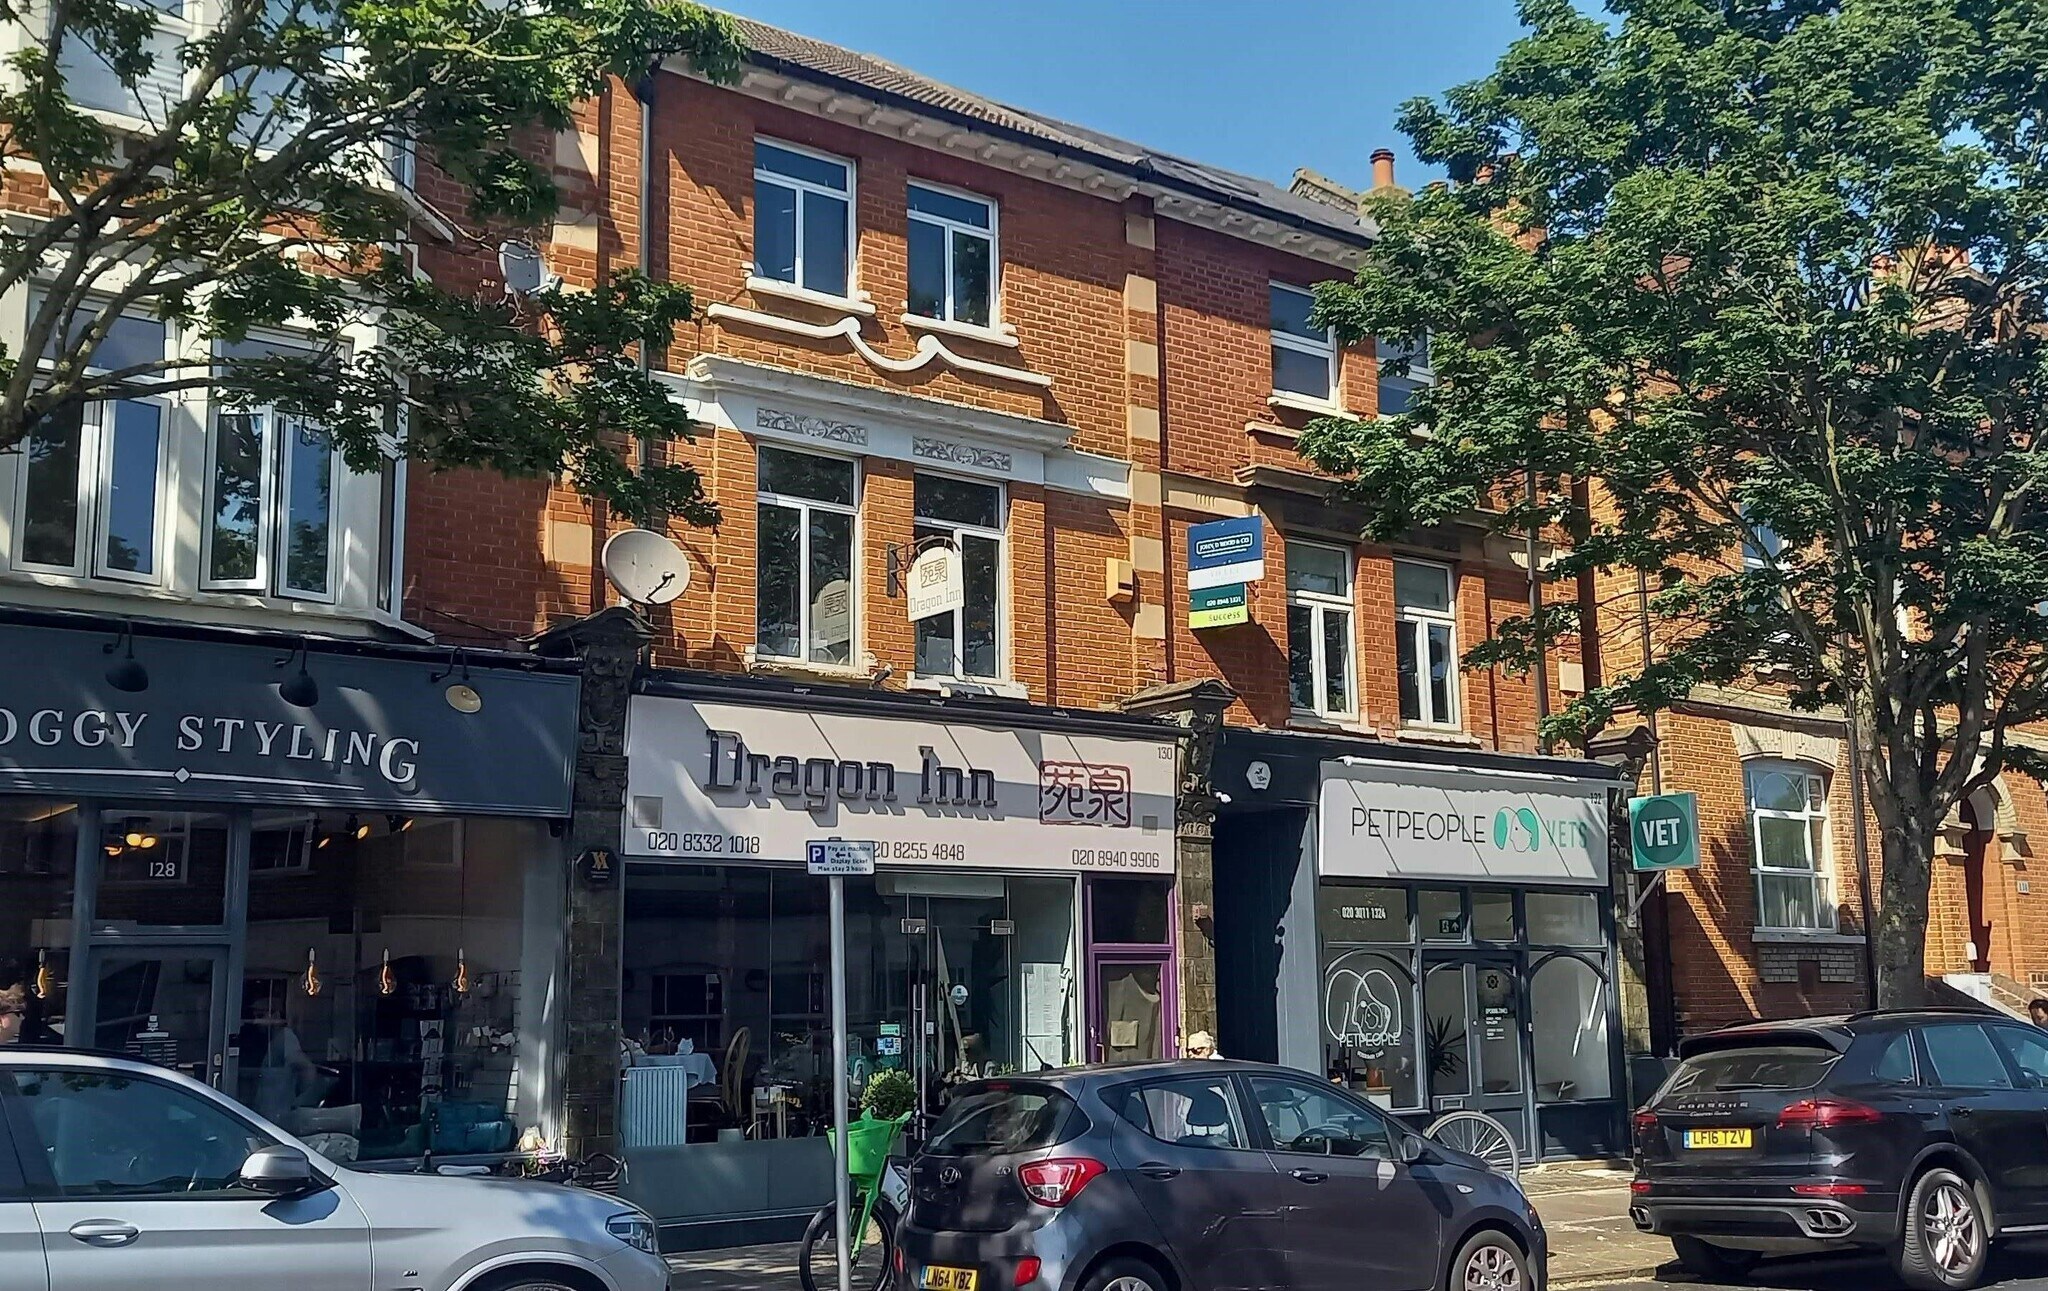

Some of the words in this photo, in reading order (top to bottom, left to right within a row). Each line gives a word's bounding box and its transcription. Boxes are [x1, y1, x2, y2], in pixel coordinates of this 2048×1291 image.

[910, 594, 943, 614] Dragon
[945, 586, 962, 603] Inn
[176, 715, 421, 784] STYLING
[1157, 746, 1173, 761] 130
[705, 728, 898, 811] Dragon
[917, 745, 998, 807] Inn
[1042, 765, 1128, 823] 苑泉
[1590, 792, 1602, 805] 132
[1351, 807, 1486, 844] PETPEOPLE
[1546, 818, 1588, 850] VETS
[1641, 817, 1681, 847] VET
[648, 831, 678, 851] 020
[682, 833, 722, 853] 8332
[729, 835, 760, 854] 1018
[874, 841, 889, 859] 20
[893, 841, 928, 860] 8255
[932, 842, 965, 861] 4848
[811, 847, 822, 862] P
[1072, 850, 1096, 866] 020
[1097, 850, 1128, 867] 8940
[1129, 851, 1160, 869] 9906
[149, 862, 176, 878] 128
[1341, 906, 1354, 919] 020
[1354, 906, 1370, 919] 3011
[1370, 907, 1387, 920] 1324
[1339, 1032, 1401, 1048] PETPEOPLE
[1693, 1130, 1719, 1145] LF16
[1723, 1129, 1746, 1145] TZV
[925, 1267, 950, 1287] LN64
[953, 1269, 973, 1290] YBZ
